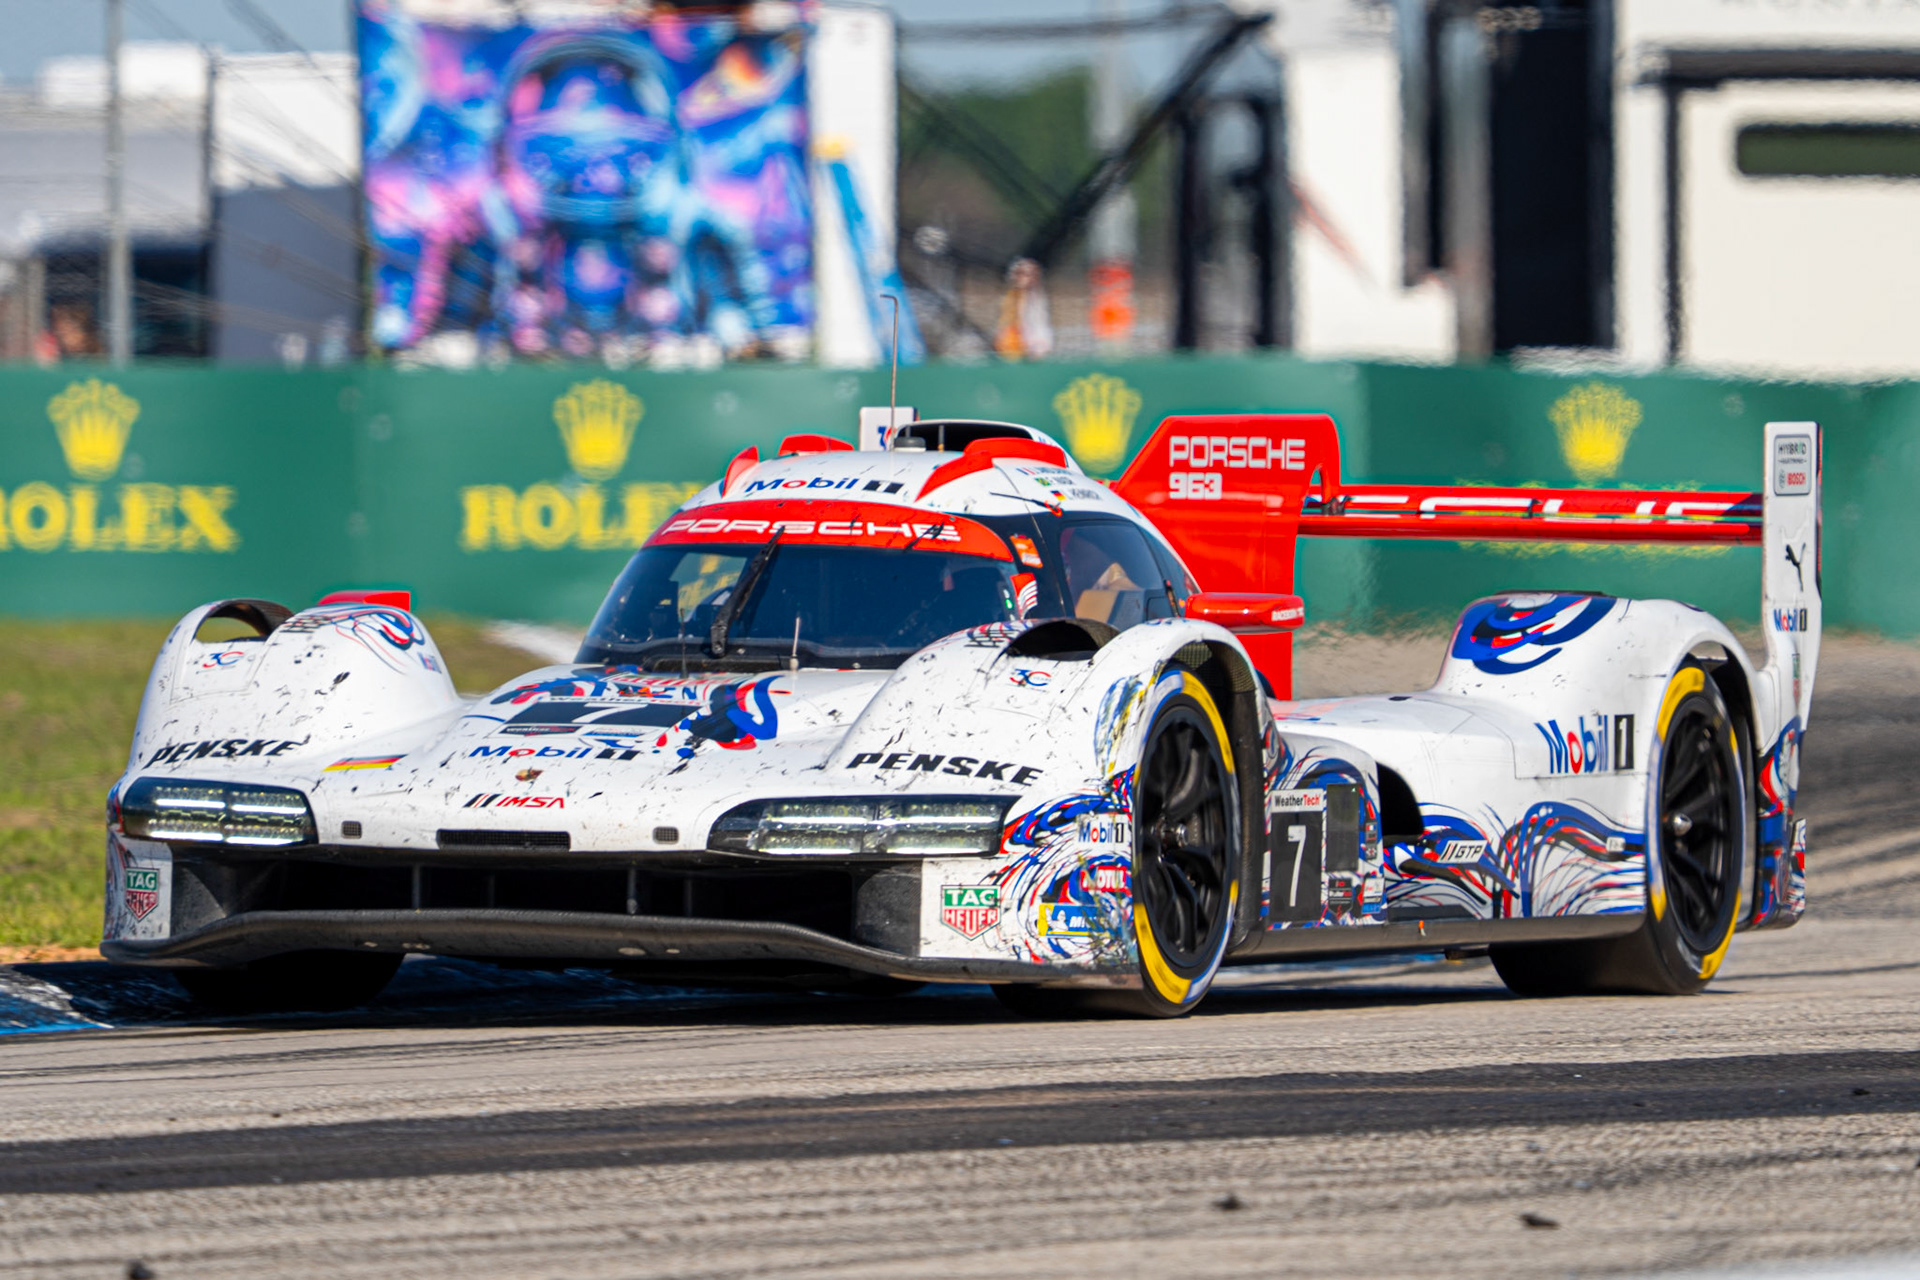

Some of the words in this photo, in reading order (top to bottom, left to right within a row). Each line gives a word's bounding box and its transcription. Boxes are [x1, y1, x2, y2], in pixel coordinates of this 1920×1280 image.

[1168, 435, 1306, 471] PORSCHE
[1778, 441, 1807, 455] HYBRID
[745, 477, 860, 494] Mobil
[1168, 472, 1222, 500] 963
[1787, 471, 1806, 486] BOSCH
[0, 481, 241, 552] OLEX
[460, 481, 703, 552] ROLE
[661, 517, 962, 542] PORSCHE
[1774, 608, 1798, 632] Mobil
[572, 702, 648, 724] 7
[143, 738, 304, 770] PENSKE
[469, 746, 593, 759] Mobil
[1534, 714, 1610, 774] Mobil
[846, 752, 1044, 787] PENSKE
[496, 795, 566, 809] IMSA
[1274, 793, 1321, 809] WeatherTech
[1078, 822, 1113, 843] Mobil
[1456, 844, 1484, 859] GTP
[1287, 824, 1307, 907] 7
[128, 872, 157, 890] TAG
[126, 891, 158, 917] HEUER
[947, 890, 997, 906] TAG
[944, 909, 998, 935] HEUER
